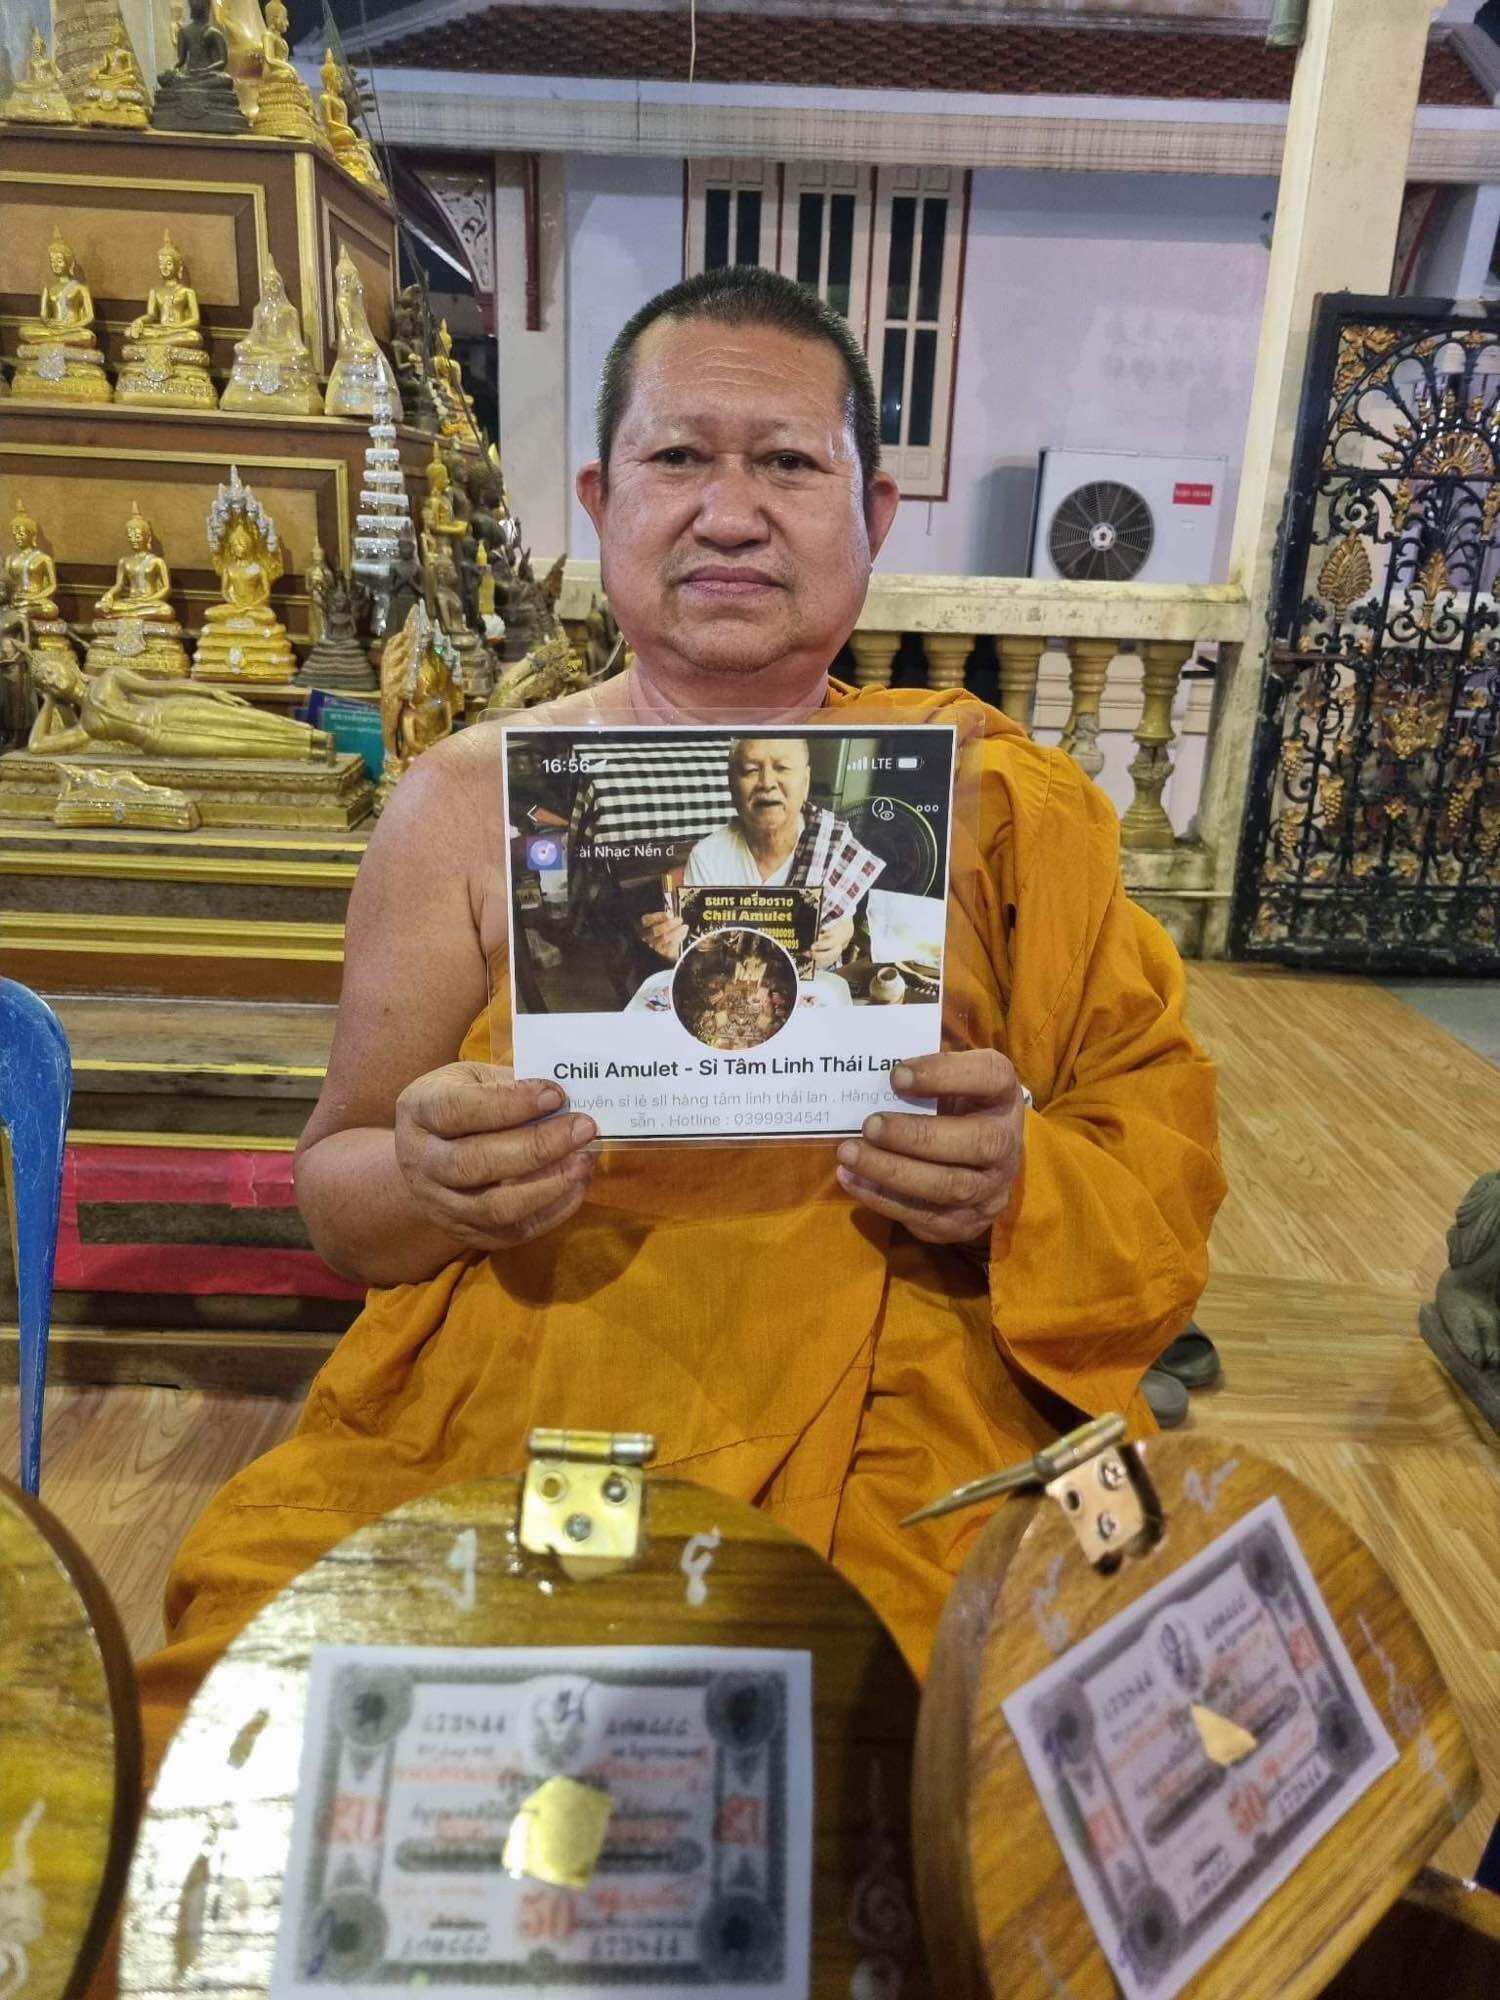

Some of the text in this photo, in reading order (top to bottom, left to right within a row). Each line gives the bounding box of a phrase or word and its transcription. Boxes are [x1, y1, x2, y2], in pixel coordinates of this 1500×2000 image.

[542, 759, 590, 773] 16:56
[871, 757, 892, 769] LTE
[595, 846, 631, 860] Nhạc
[702, 910, 792, 921] Chili Amulet
[553, 1062, 599, 1080] Chili
[605, 1061, 679, 1078] Amulet
[723, 1057, 766, 1075] Tâm
[772, 1057, 814, 1074] Linh
[820, 1055, 862, 1073] Thái
[745, 1091, 771, 1105] linh
[807, 1090, 827, 1104] lan
[670, 1114, 721, 1127] Hotline
[734, 1111, 830, 1126] 0399934541
